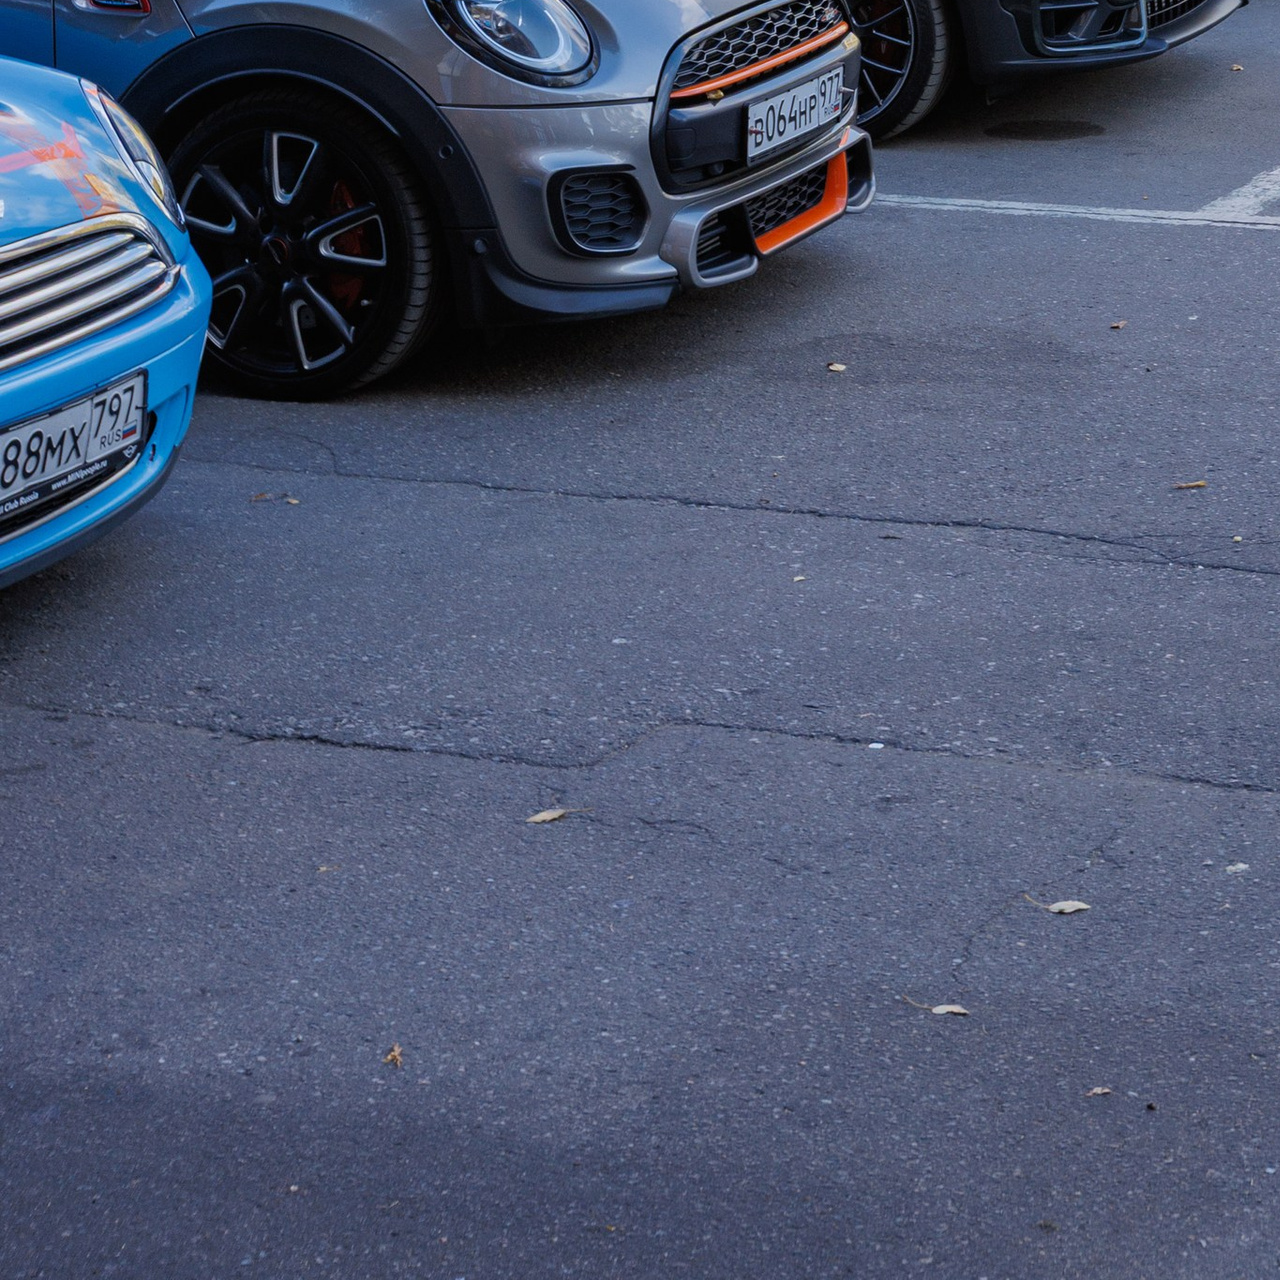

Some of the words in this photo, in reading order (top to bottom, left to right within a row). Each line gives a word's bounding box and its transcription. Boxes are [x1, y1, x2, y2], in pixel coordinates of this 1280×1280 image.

[820, 72, 841, 108] 977
[93, 384, 135, 439] 797
[100, 428, 122, 450] RUS
